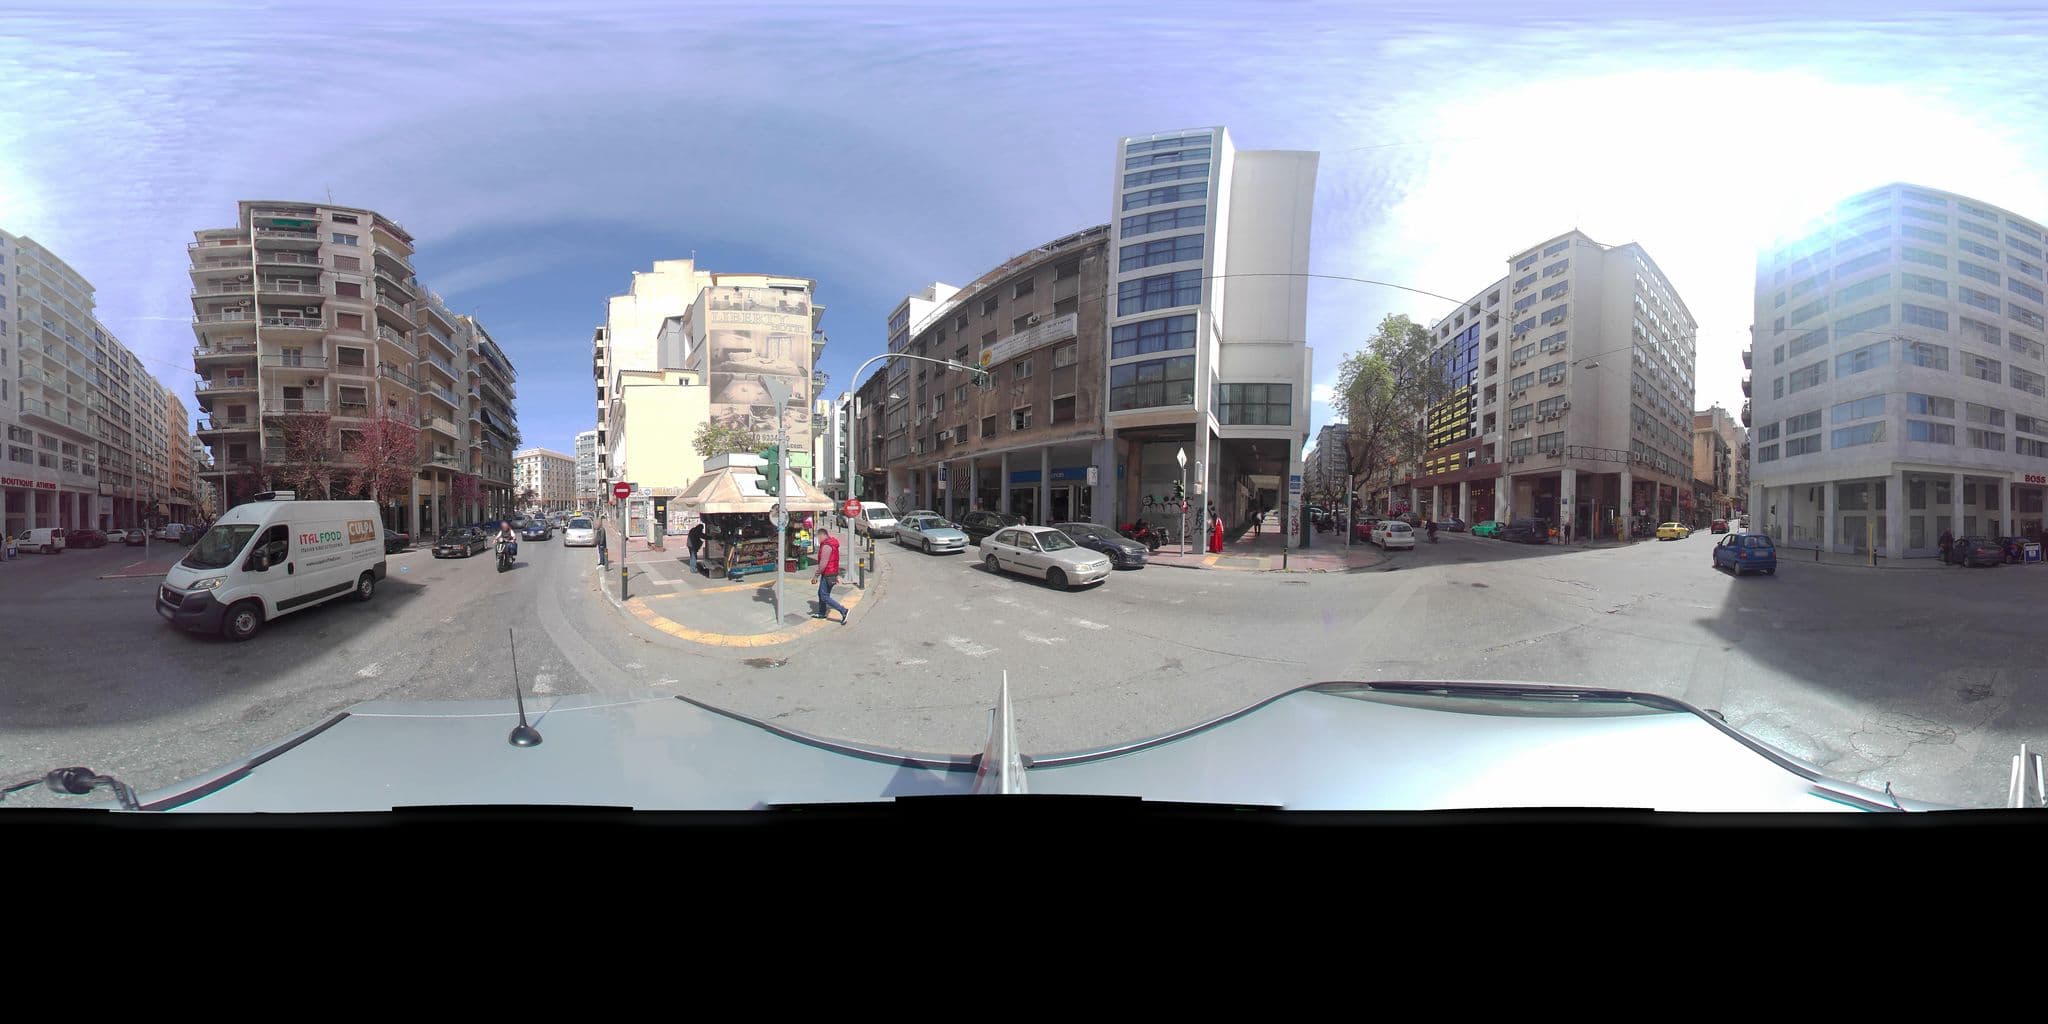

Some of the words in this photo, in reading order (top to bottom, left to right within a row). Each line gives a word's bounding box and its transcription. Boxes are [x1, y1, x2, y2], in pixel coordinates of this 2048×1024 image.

[711, 311, 787, 326] LIBERTY
[1, 477, 33, 488] BOUTIQUE
[36, 480, 56, 490] ATHENS
[2024, 474, 2047, 484] BOSS
[349, 521, 374, 536] CULPA
